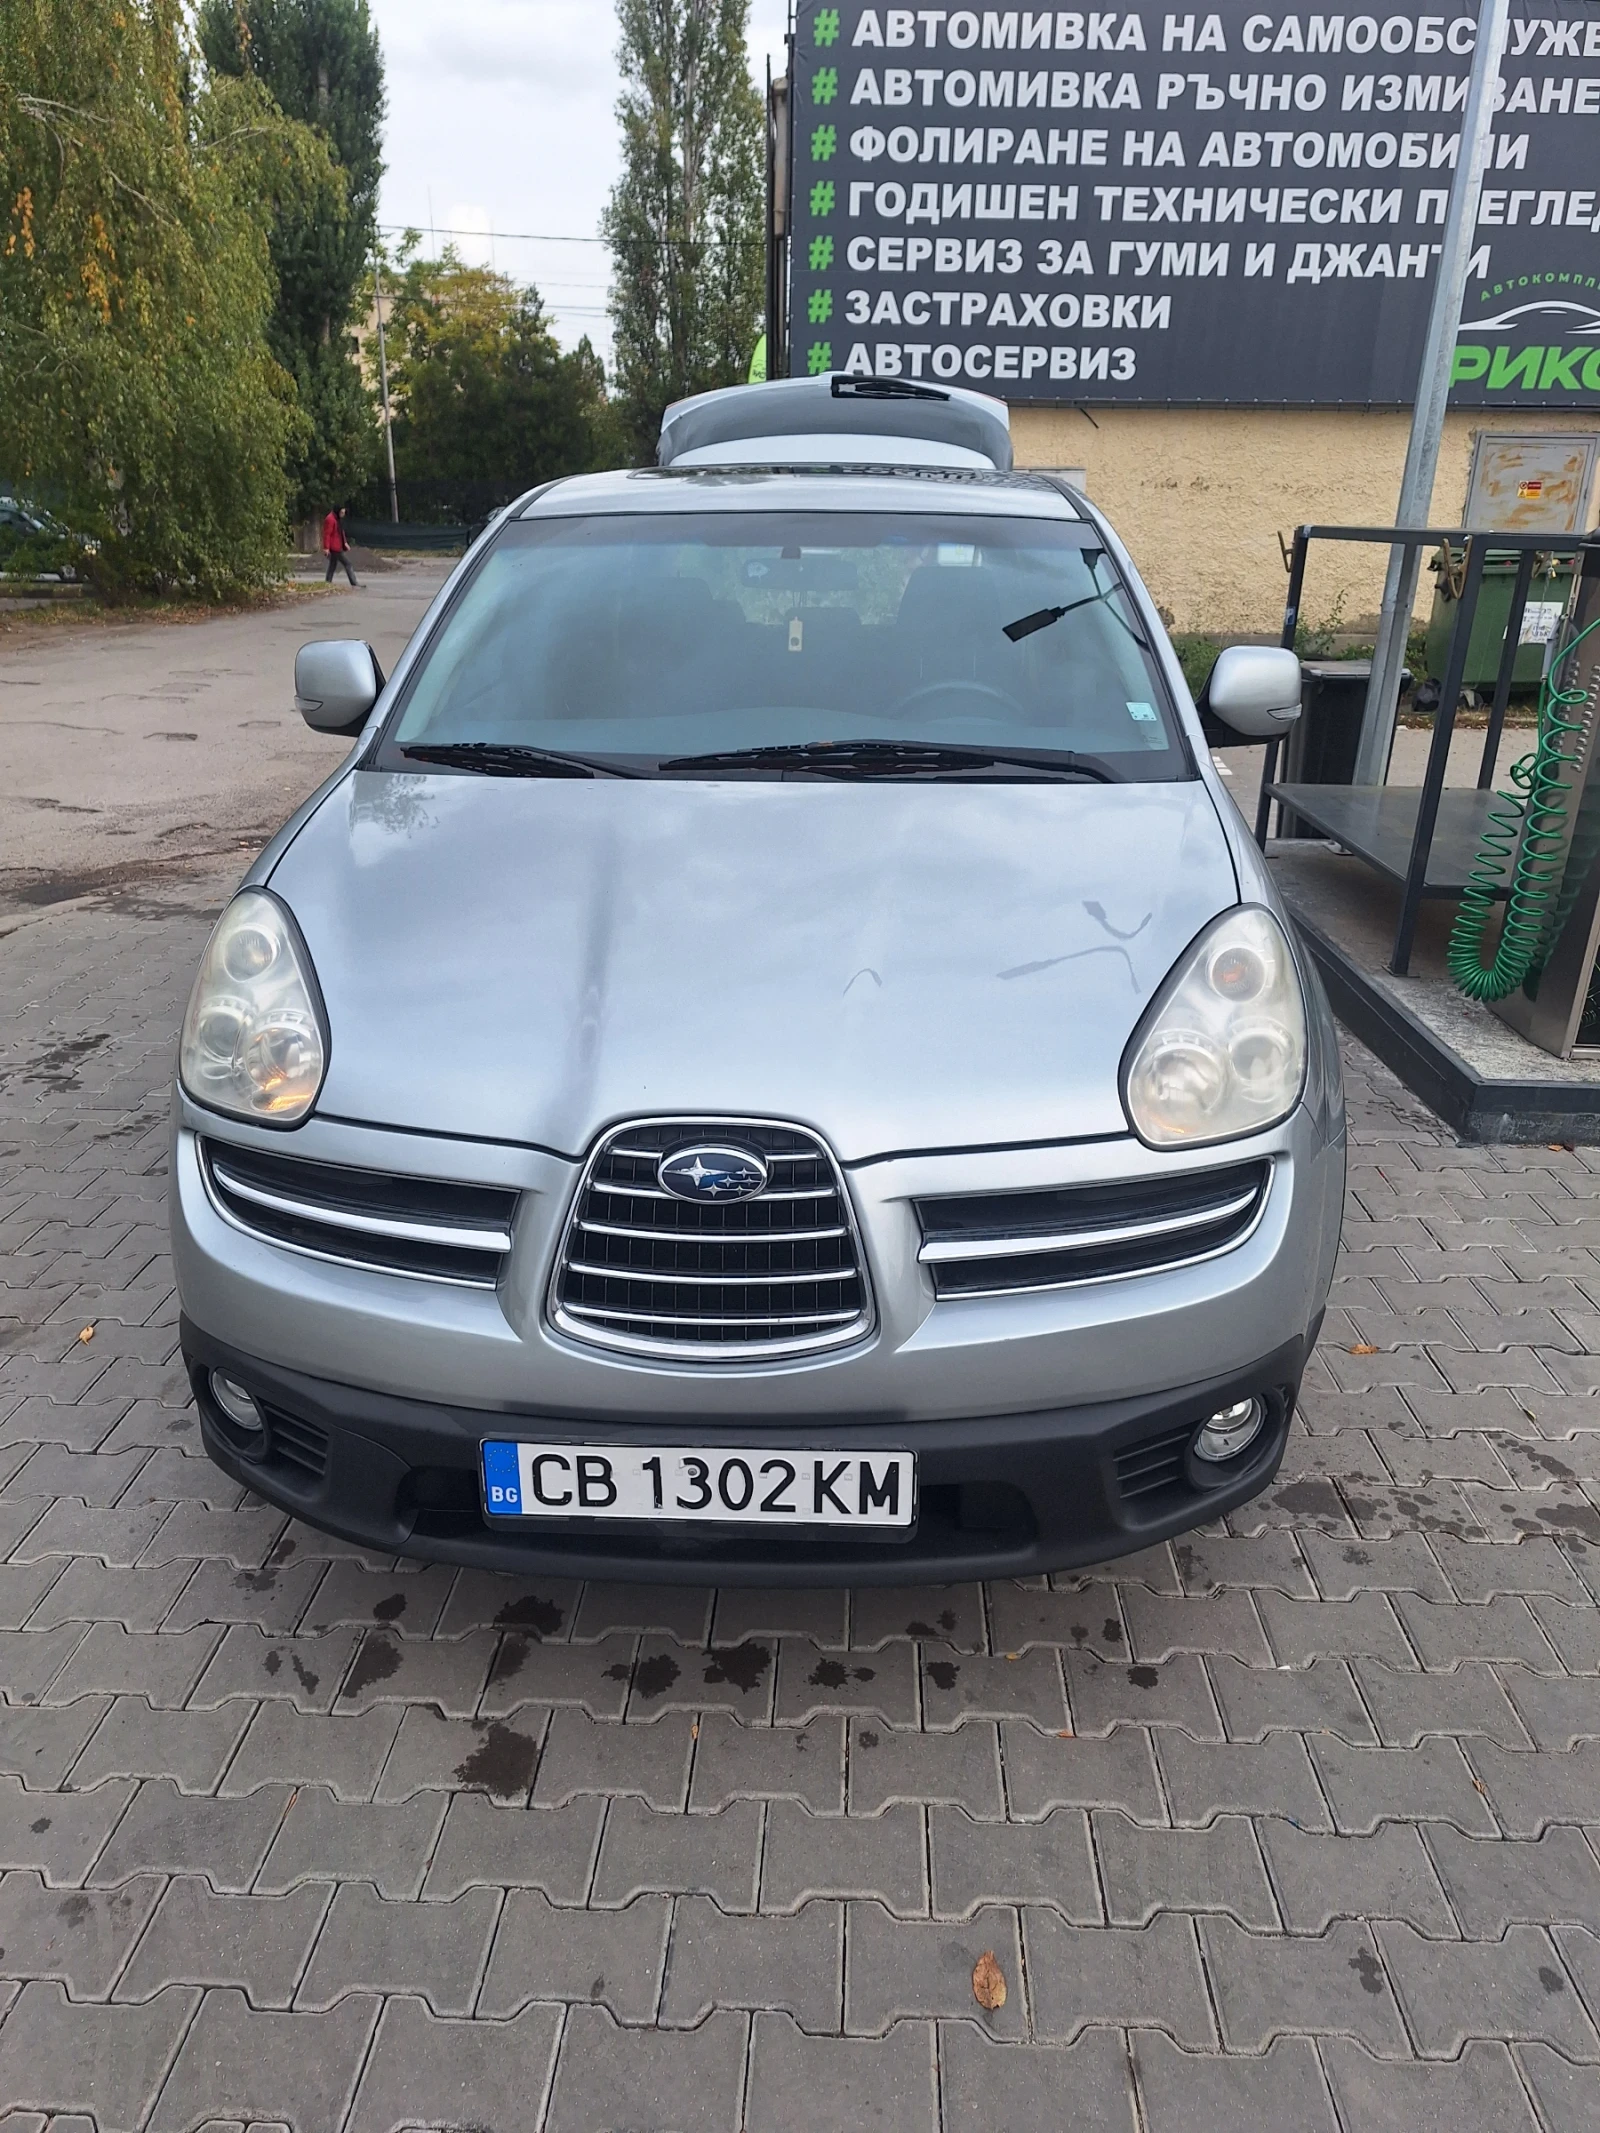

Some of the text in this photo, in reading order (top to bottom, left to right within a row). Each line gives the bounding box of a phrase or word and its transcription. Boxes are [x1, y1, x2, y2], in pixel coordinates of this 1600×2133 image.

[851, 9, 1147, 52] АВТОМИВКА
[1162, 14, 1227, 52] НА
[850, 68, 1142, 110] АВТОМИВКА
[1156, 73, 1330, 112] РЪЧНО
[849, 126, 1109, 166] ФОЛИРАНЕ
[1122, 130, 1186, 167] НА
[848, 181, 1079, 225] ГОДИШЕН
[1093, 185, 1403, 224] ТЕХНИЧЕСКИ
[1415, 189, 1600, 233] ПЕГЛЕ
[846, 236, 1023, 274] СЕРВИЗ
[1037, 239, 1094, 275] ЗА
[1108, 241, 1230, 277] ГУМИ
[1244, 242, 1276, 277] И
[1480, 271, 1600, 302] АВТОКОМПЛ
[845, 289, 1171, 329] ЗАСТРАХОВКИ
[844, 342, 1136, 381] АВТОСЕРВИЗ
[491, 1486, 518, 1504] BG
[531, 1453, 900, 1516] CB 1302 KM
